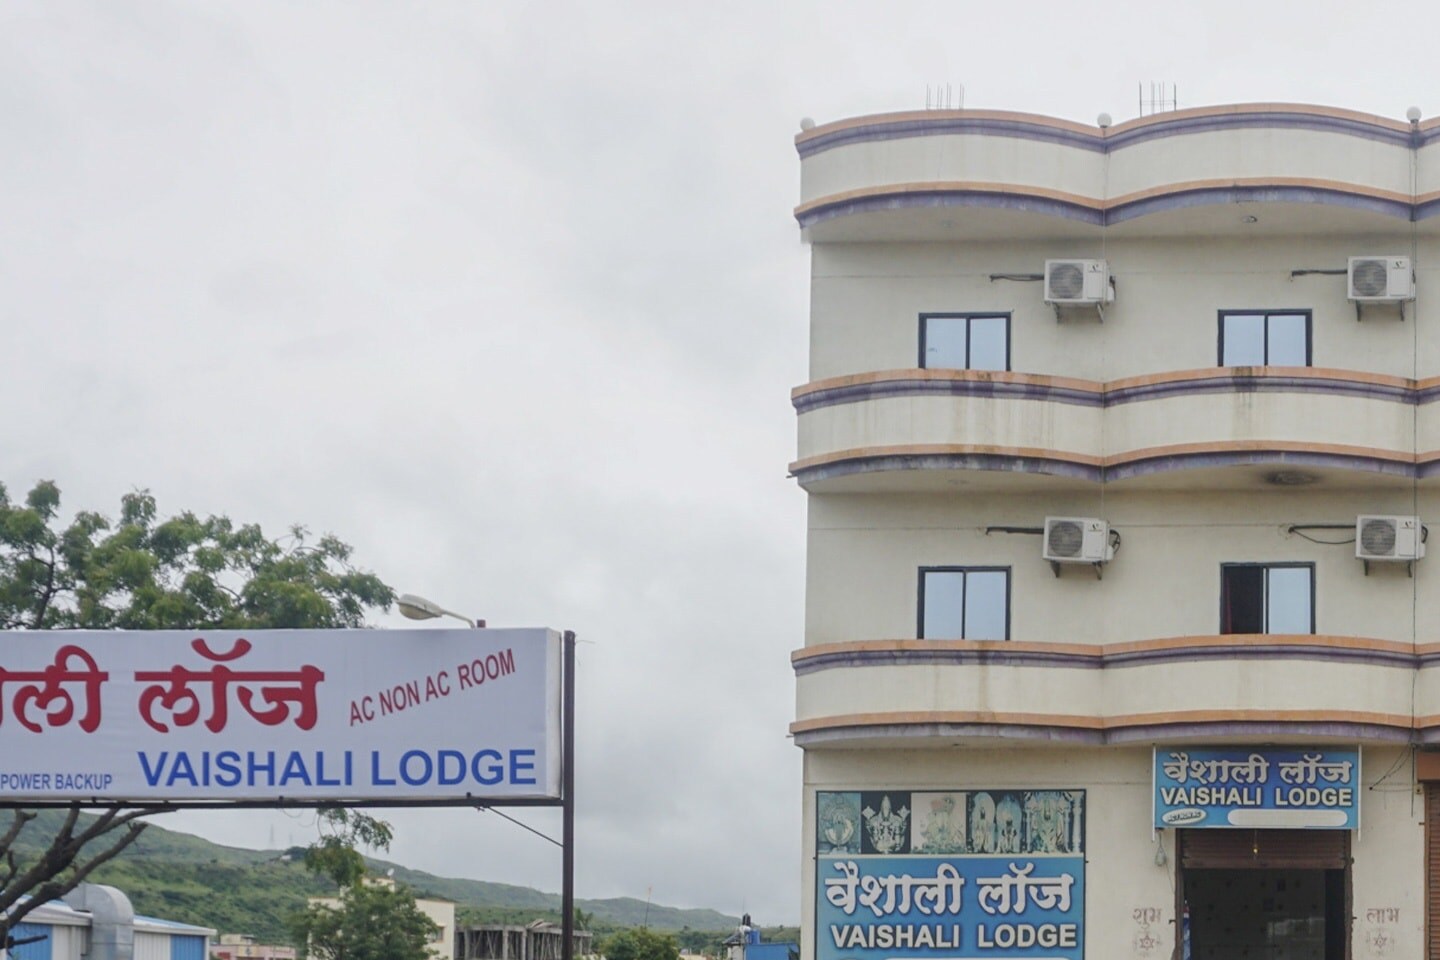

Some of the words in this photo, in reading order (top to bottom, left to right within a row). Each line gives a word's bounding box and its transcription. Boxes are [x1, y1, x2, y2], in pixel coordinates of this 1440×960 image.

[0, 645, 109, 734] ली
[134, 638, 325, 734] लॉज
[350, 695, 375, 727] AC
[378, 679, 421, 717] NON
[425, 670, 451, 702] AC
[457, 647, 516, 691] ROOM
[0, 773, 52, 791] POWER
[54, 773, 113, 791] BACKUP
[137, 750, 353, 788] VAISHALI
[370, 749, 536, 786] LODGE
[1278, 753, 1353, 786] लॉज
[1160, 786, 1262, 806] VAISHALI
[1275, 786, 1353, 806] LODGE
[976, 862, 1075, 915] लॉज
[830, 923, 960, 949] VAISHALI
[977, 923, 1077, 948] LODGE
